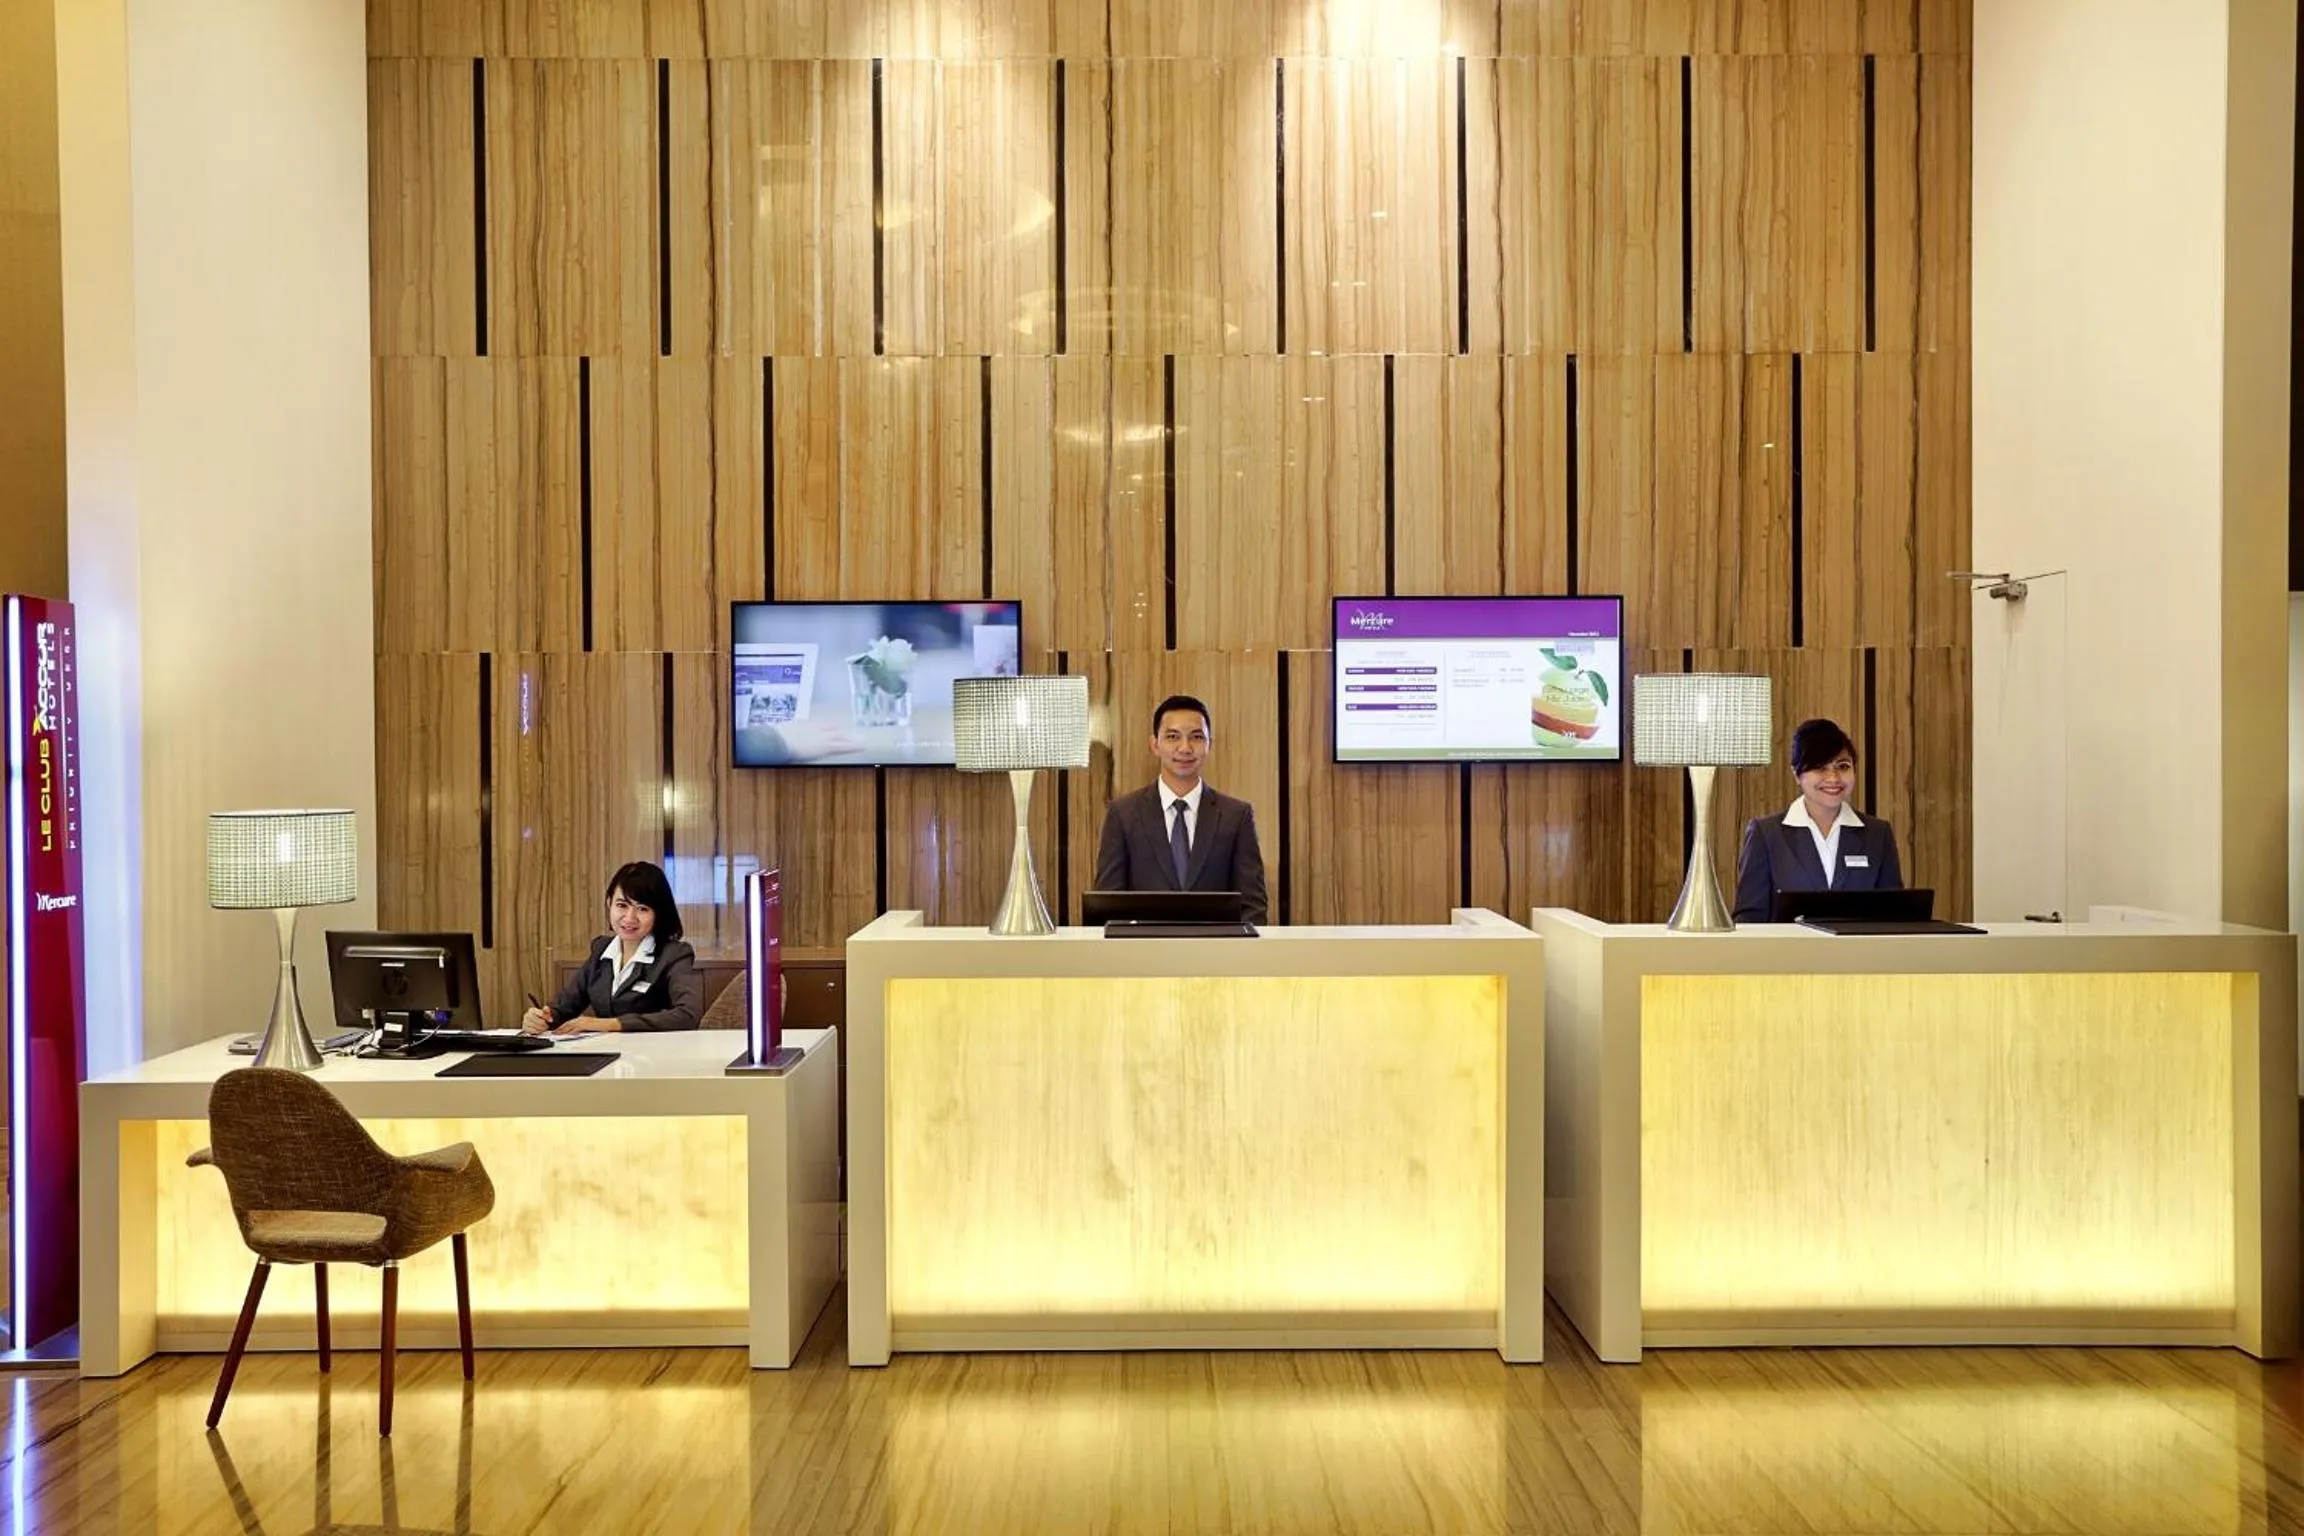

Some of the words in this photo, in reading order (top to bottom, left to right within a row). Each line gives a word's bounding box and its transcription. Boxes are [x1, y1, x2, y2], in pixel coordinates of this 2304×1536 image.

[37, 621, 49, 731] ACCOR
[47, 623, 56, 730] HOTELS
[40, 738, 50, 814] CLUB
[41, 819, 51, 851] LE
